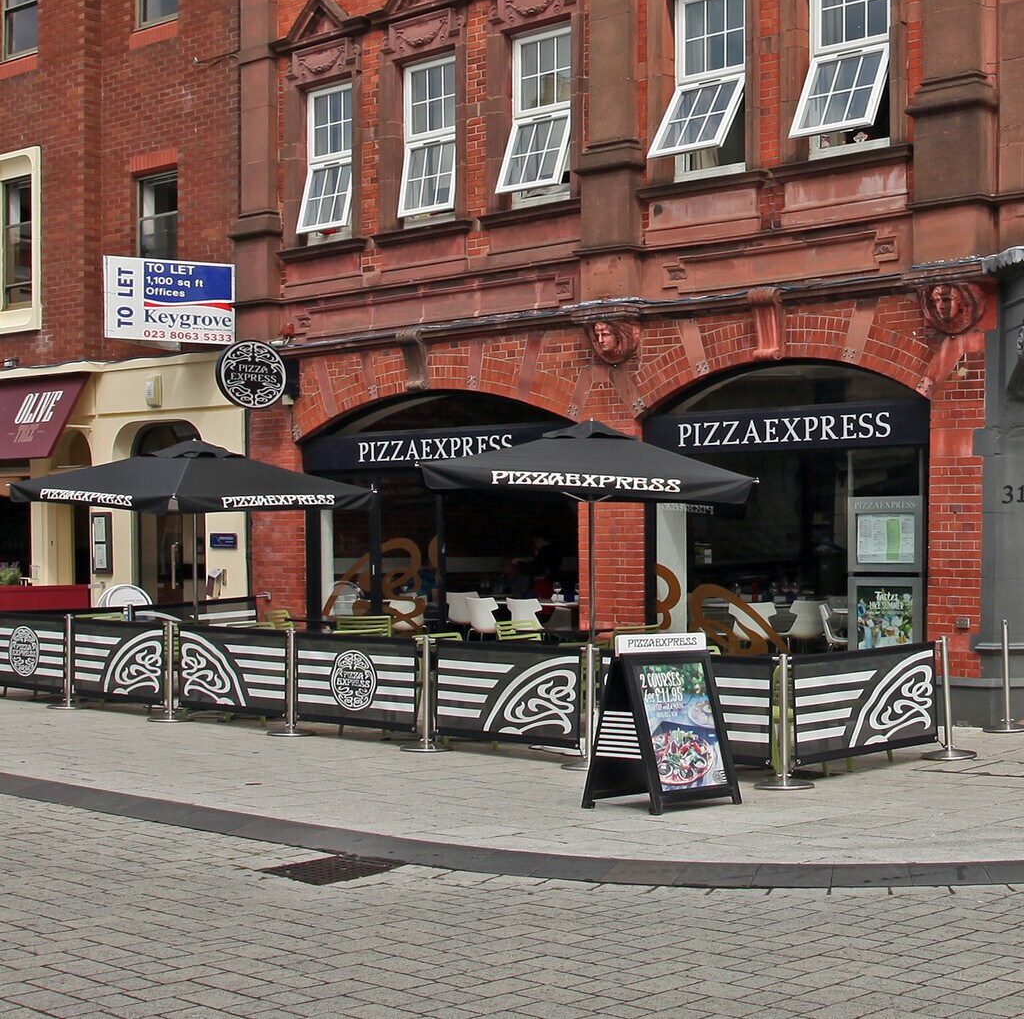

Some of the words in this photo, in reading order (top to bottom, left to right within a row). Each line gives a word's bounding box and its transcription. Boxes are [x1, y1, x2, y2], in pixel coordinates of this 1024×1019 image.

[146, 263, 164, 273] TO
[170, 265, 195, 275] LET
[118, 267, 133, 297] LET
[146, 276, 173, 286] 1,100
[178, 279, 190, 288] sq
[195, 279, 203, 287] ft
[146, 288, 185, 297] Offices
[117, 306, 133, 328] TO
[144, 309, 232, 328] Keygrove
[144, 330, 165, 338] 023
[170, 331, 199, 340] 8063
[204, 333, 232, 341] 5333
[238, 363, 268, 373] PIZZA
[230, 372, 277, 383] EXPRESS
[14, 390, 63, 424] OLIVE
[678, 412, 892, 447] PIZZAEXPRESS
[358, 434, 512, 462] PIZZAEXPRESS
[490, 470, 681, 493] PIZZAEXPRESS
[40, 488, 133, 506] PIZZAEXPRESS
[221, 494, 335, 508] PIZZAEXPRESS
[855, 501, 915, 509] PIZZAEXPRESS
[627, 637, 698, 648] PIZZAEXPRESS
[336, 677, 370, 688] EXPRESS
[342, 671, 364, 680] PIZZA
[640, 673, 647, 688] 2
[647, 671, 681, 687] COURSES
[655, 686, 683, 703] £11.95
